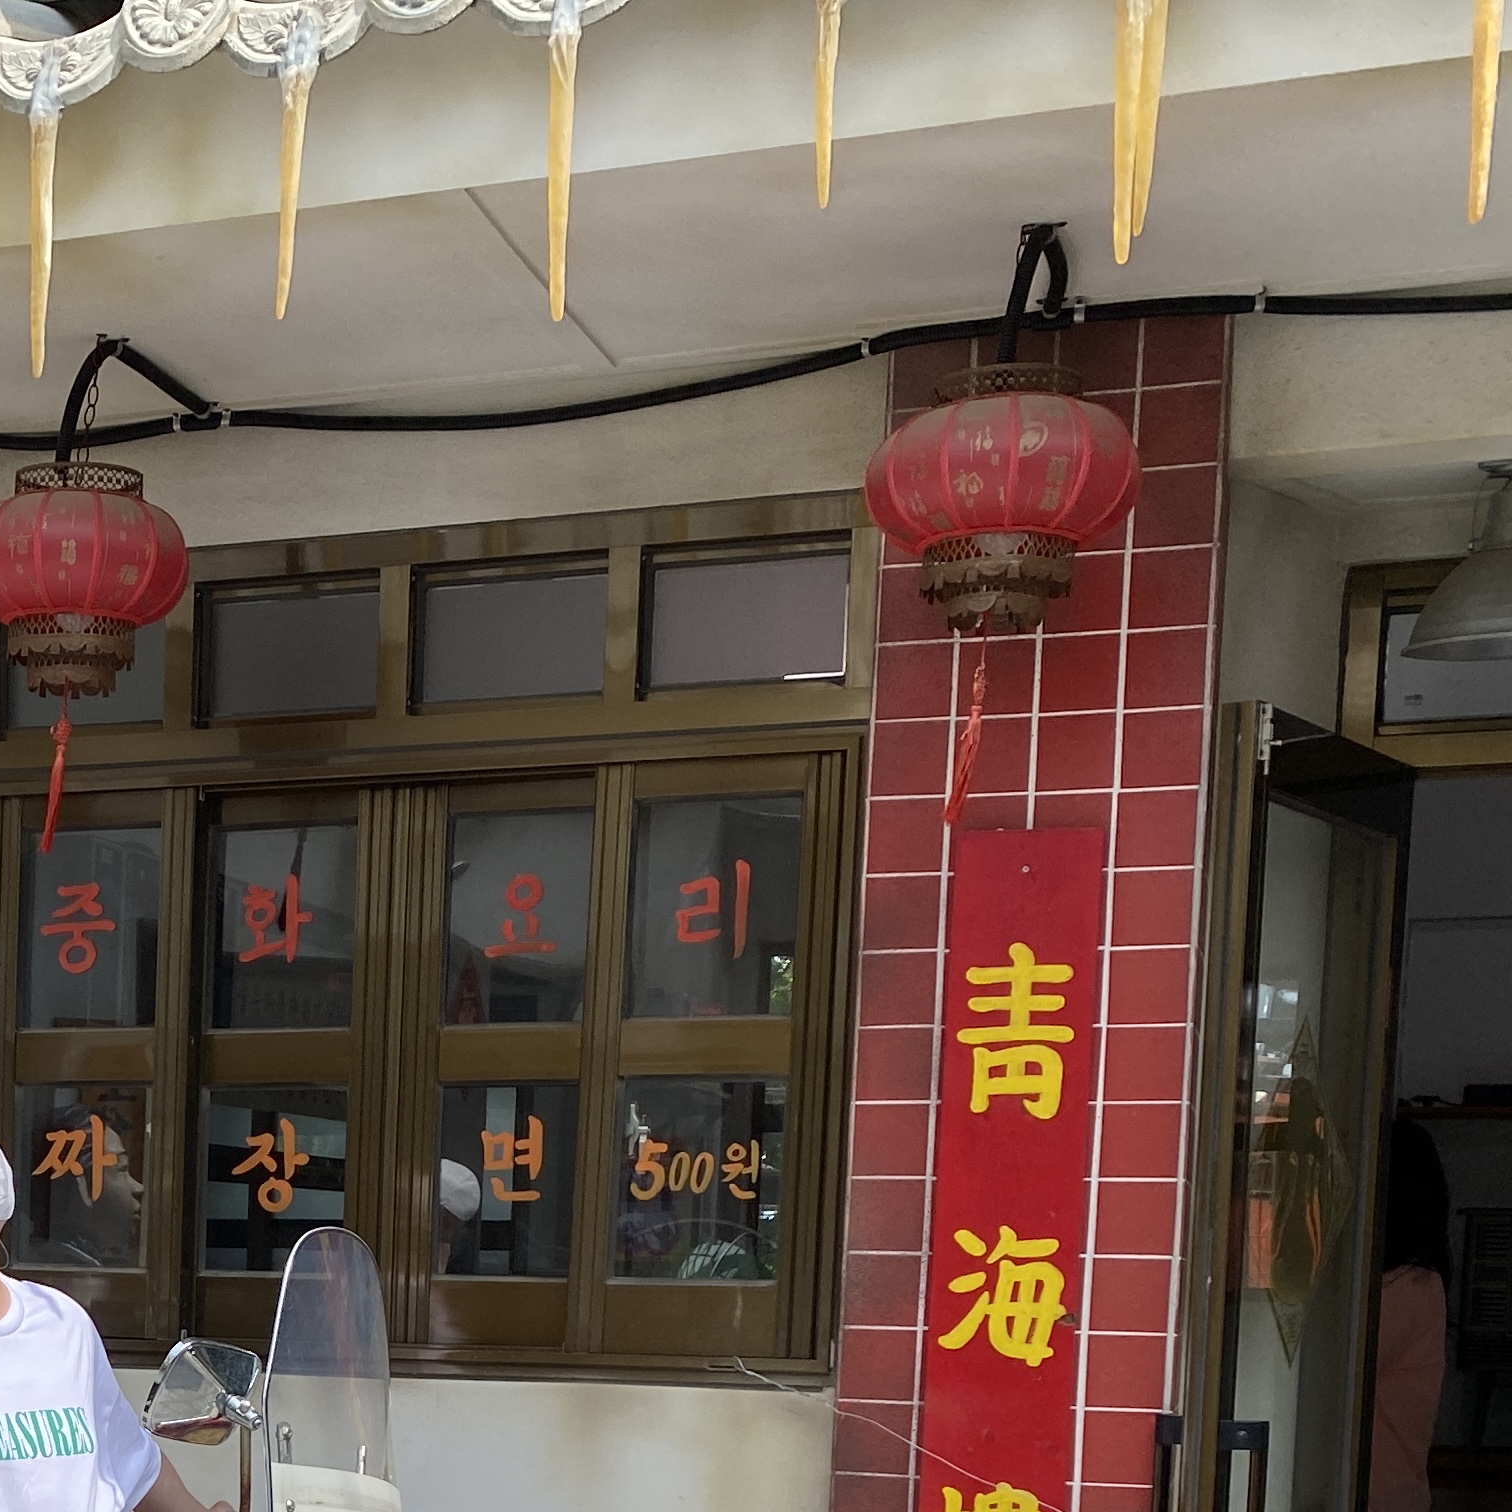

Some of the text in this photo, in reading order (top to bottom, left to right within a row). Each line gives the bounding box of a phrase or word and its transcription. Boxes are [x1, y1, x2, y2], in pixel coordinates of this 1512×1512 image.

[40, 859, 751, 973] 중화요리
[32, 1114, 761, 1213] 짜장면 500원
